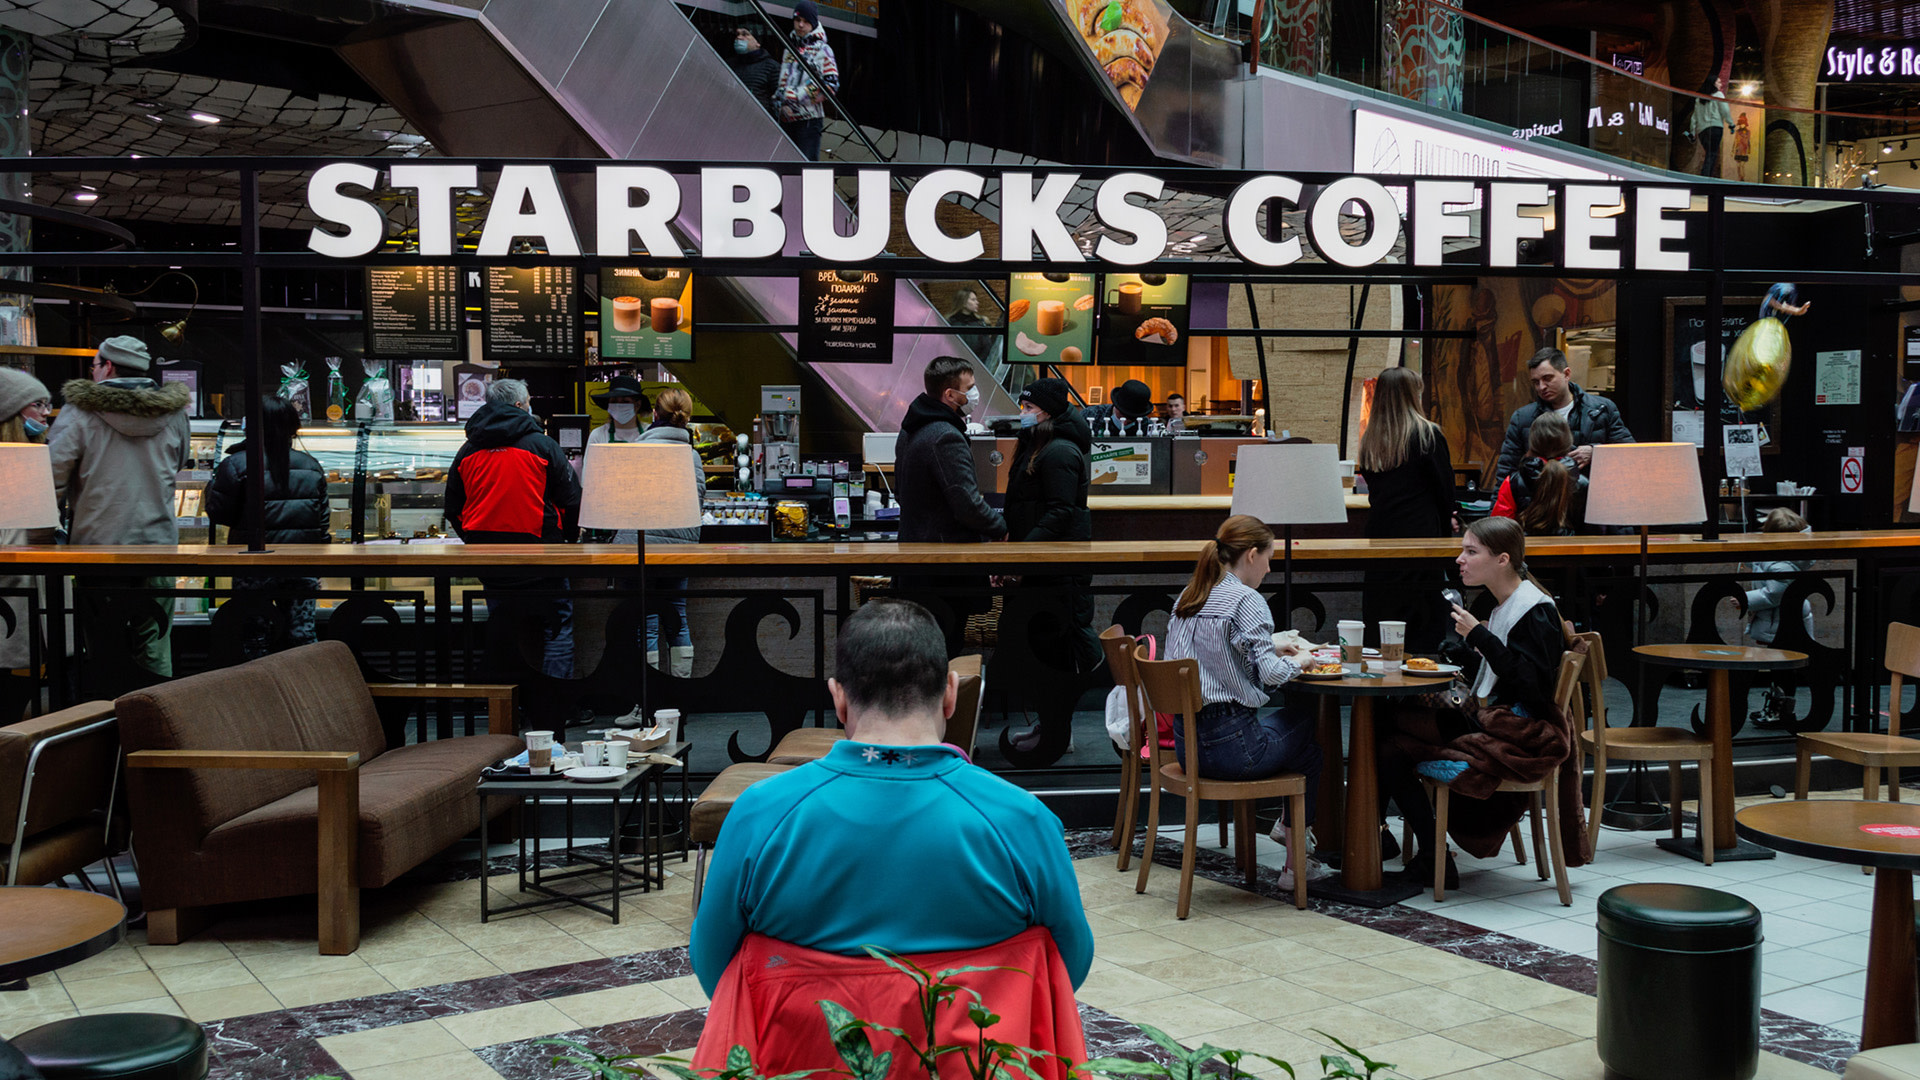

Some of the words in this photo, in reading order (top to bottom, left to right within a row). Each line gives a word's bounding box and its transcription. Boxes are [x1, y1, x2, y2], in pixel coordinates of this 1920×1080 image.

[1827, 46, 1875, 82] Style
[1879, 46, 1897, 76] &
[307, 162, 1168, 266] STARBUCKS
[1226, 174, 1691, 271] COFFEE
[613, 268, 642, 277] ЗИМНИ
